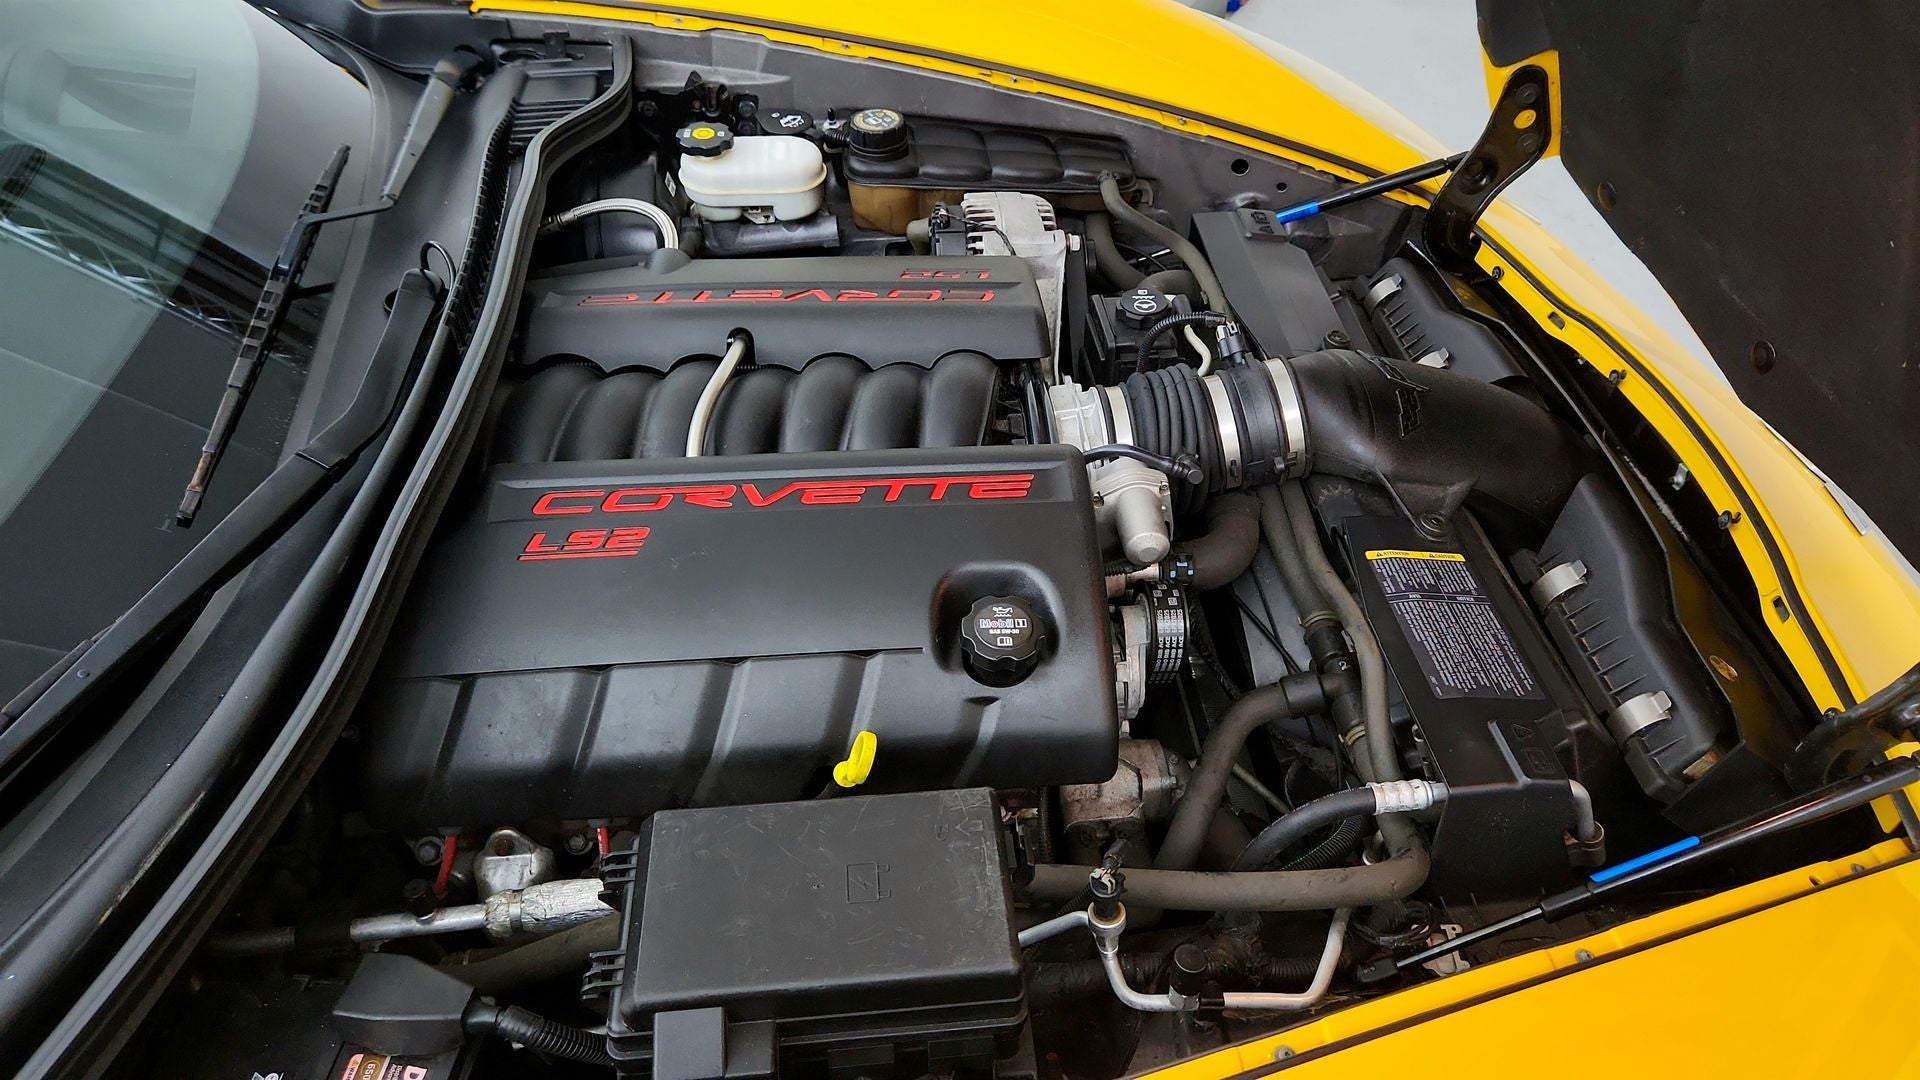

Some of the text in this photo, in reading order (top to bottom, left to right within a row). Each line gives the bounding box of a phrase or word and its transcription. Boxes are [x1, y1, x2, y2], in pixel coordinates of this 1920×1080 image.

[577, 290, 995, 306] CORVETTE
[532, 474, 1034, 515] CORVETTE
[524, 526, 651, 553] LS2
[980, 619, 1014, 628] Mobil
